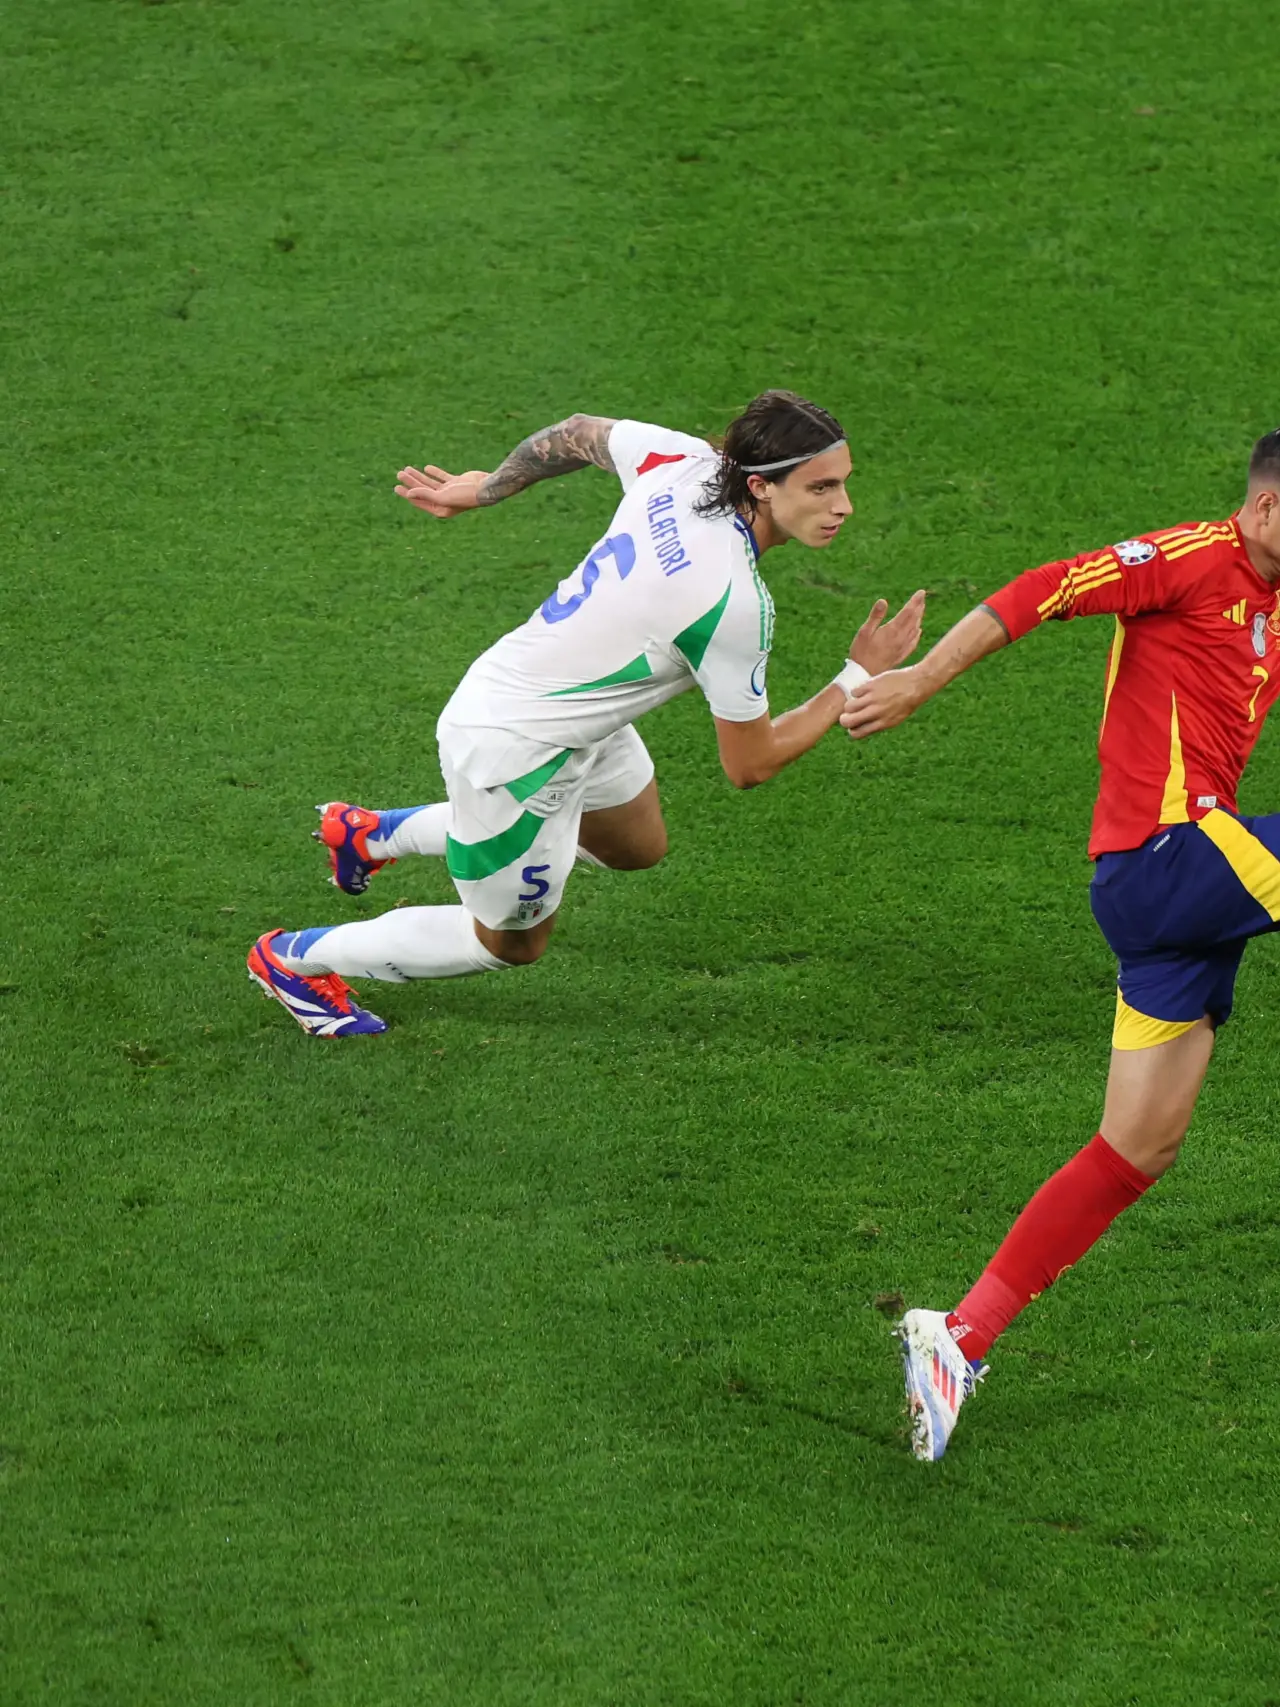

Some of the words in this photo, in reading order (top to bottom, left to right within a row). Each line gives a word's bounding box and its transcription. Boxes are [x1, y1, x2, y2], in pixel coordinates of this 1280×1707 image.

[647, 486, 692, 577] ALAFIORI
[541, 533, 636, 624] 5
[1248, 665, 1269, 723] 7
[518, 864, 551, 901] 5
